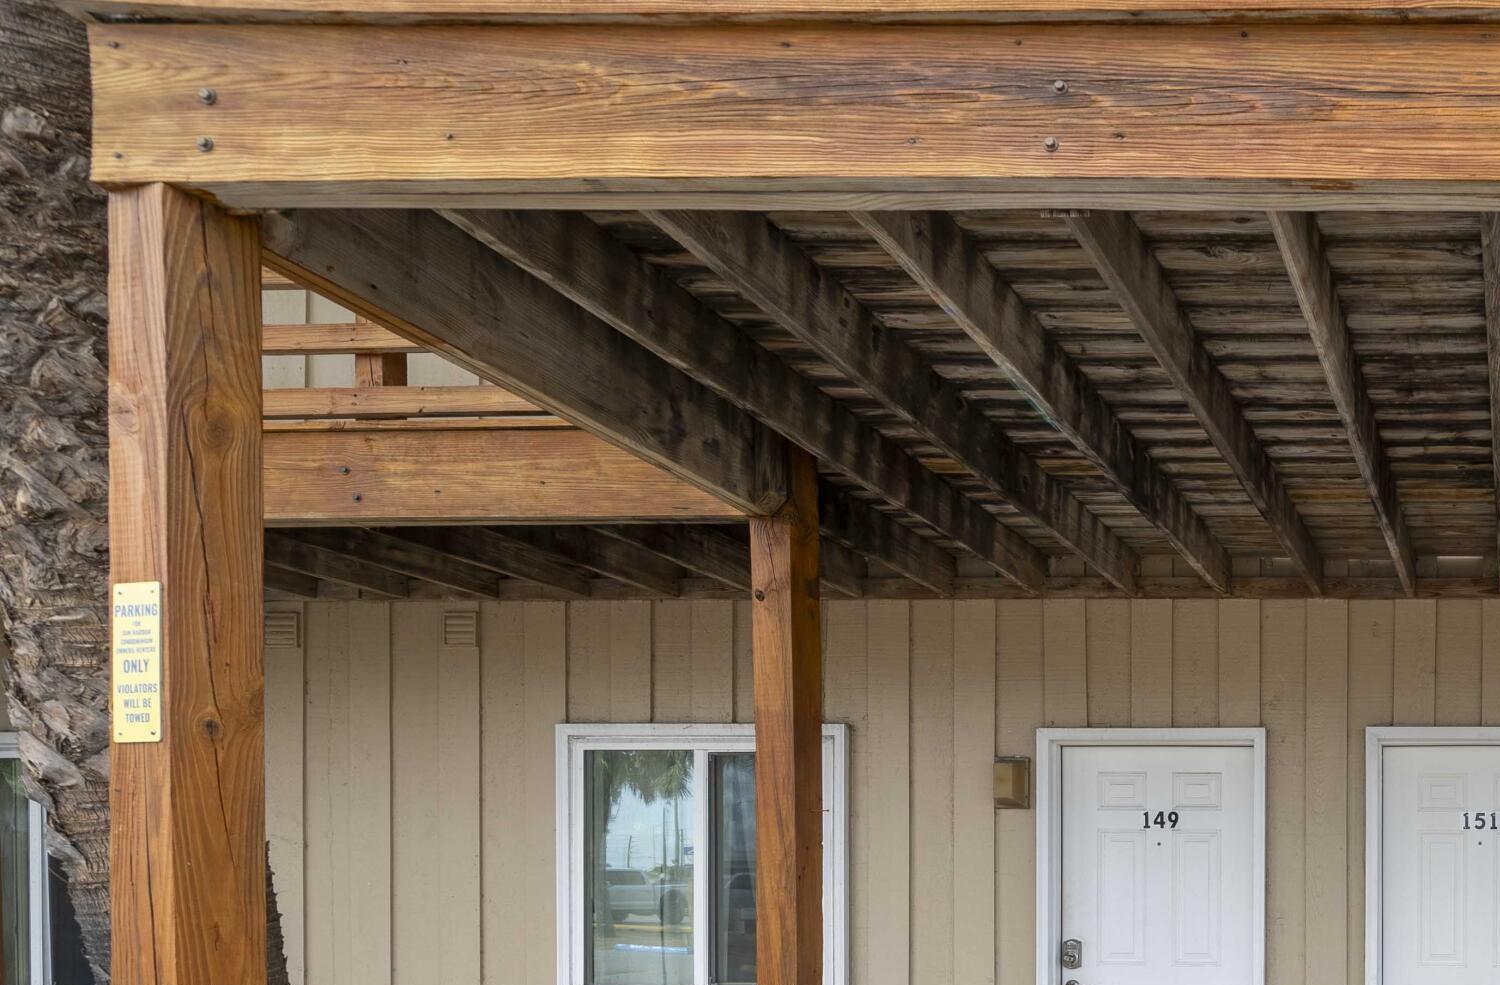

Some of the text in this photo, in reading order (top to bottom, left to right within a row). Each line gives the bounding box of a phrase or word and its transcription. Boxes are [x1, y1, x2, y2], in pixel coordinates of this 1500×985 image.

[115, 603, 158, 617] PARKING
[123, 659, 149, 673] ONLY
[117, 683, 158, 694] VIOLATORS
[123, 698, 152, 708] WILL BE
[126, 712, 150, 723] TOWED
[1143, 811, 1179, 829] 149
[1463, 812, 1498, 830] 151
